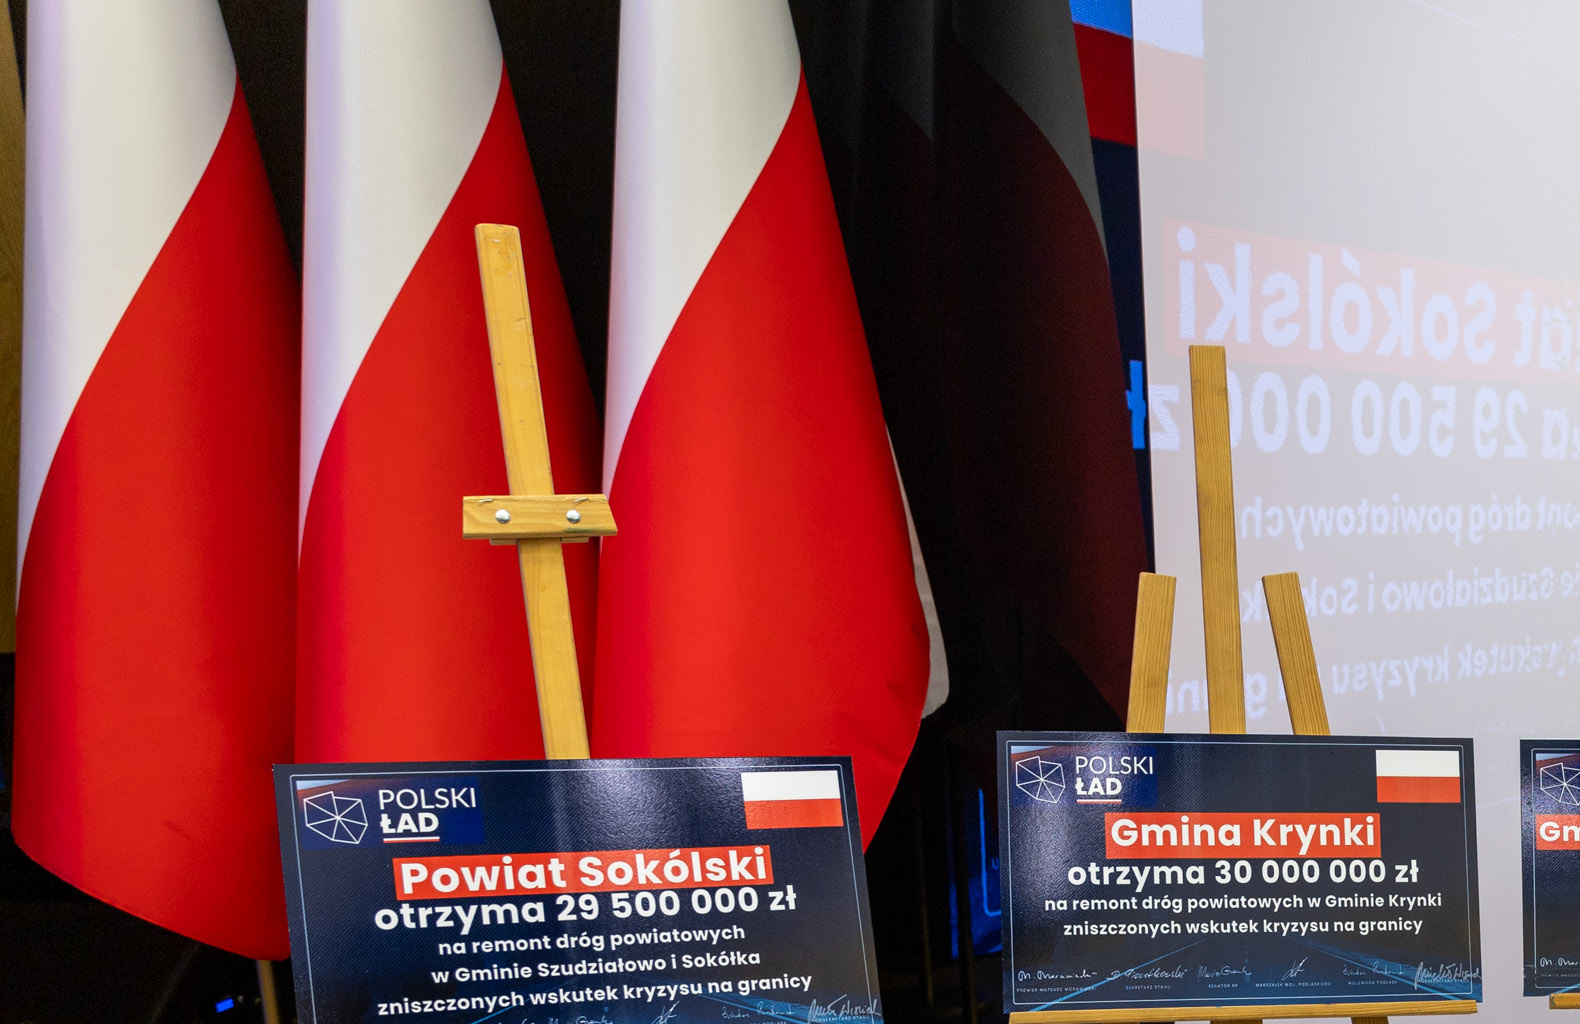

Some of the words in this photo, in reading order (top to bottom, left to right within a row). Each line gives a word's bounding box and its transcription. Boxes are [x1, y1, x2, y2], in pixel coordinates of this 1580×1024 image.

[1074, 751, 1154, 777] POLSKI
[377, 786, 477, 811] POLSKI
[1073, 774, 1124, 797] ŁAD
[378, 811, 440, 835] ŁAD
[1109, 814, 1242, 848] Gmina
[1252, 814, 1376, 854] Krynki
[400, 854, 568, 895] Powiat
[577, 845, 768, 888] Sokólski
[1066, 861, 1206, 894] otrzyma
[1213, 858, 1253, 886] 30
[1260, 858, 1321, 885] 000
[1328, 858, 1387, 884] 000
[1393, 858, 1420, 884] zł
[373, 900, 546, 936] otrzyma
[554, 892, 600, 922] 29
[609, 889, 682, 920] 500
[690, 885, 760, 916] 000
[767, 883, 798, 912] zł
[1043, 898, 1069, 912] na
[1071, 895, 1139, 912] remont
[1140, 893, 1184, 915] dróg
[1186, 893, 1304, 915] powiatowych
[1306, 896, 1323, 909] w
[1324, 892, 1386, 909] Gminie
[1387, 891, 1443, 912] Krynki
[437, 941, 467, 956] na
[471, 934, 553, 955] remont
[555, 930, 606, 953] dróg
[609, 923, 747, 952] powiatowych
[1062, 919, 1183, 940] zniszczonych
[1184, 918, 1260, 935] wskutek
[1262, 918, 1330, 938] kryzysu
[1332, 920, 1356, 933] na
[1357, 915, 1424, 937] granicy
[430, 970, 451, 985] w
[454, 961, 533, 983] Gminie
[536, 956, 668, 978] Szudziałowo
[669, 952, 678, 970] i
[680, 949, 762, 970] Sokółka
[376, 990, 526, 1017] zniszczonych
[528, 984, 620, 1006] wskutek
[621, 981, 704, 1004] kryzysu
[706, 979, 734, 995] na
[736, 972, 813, 997] granicy
